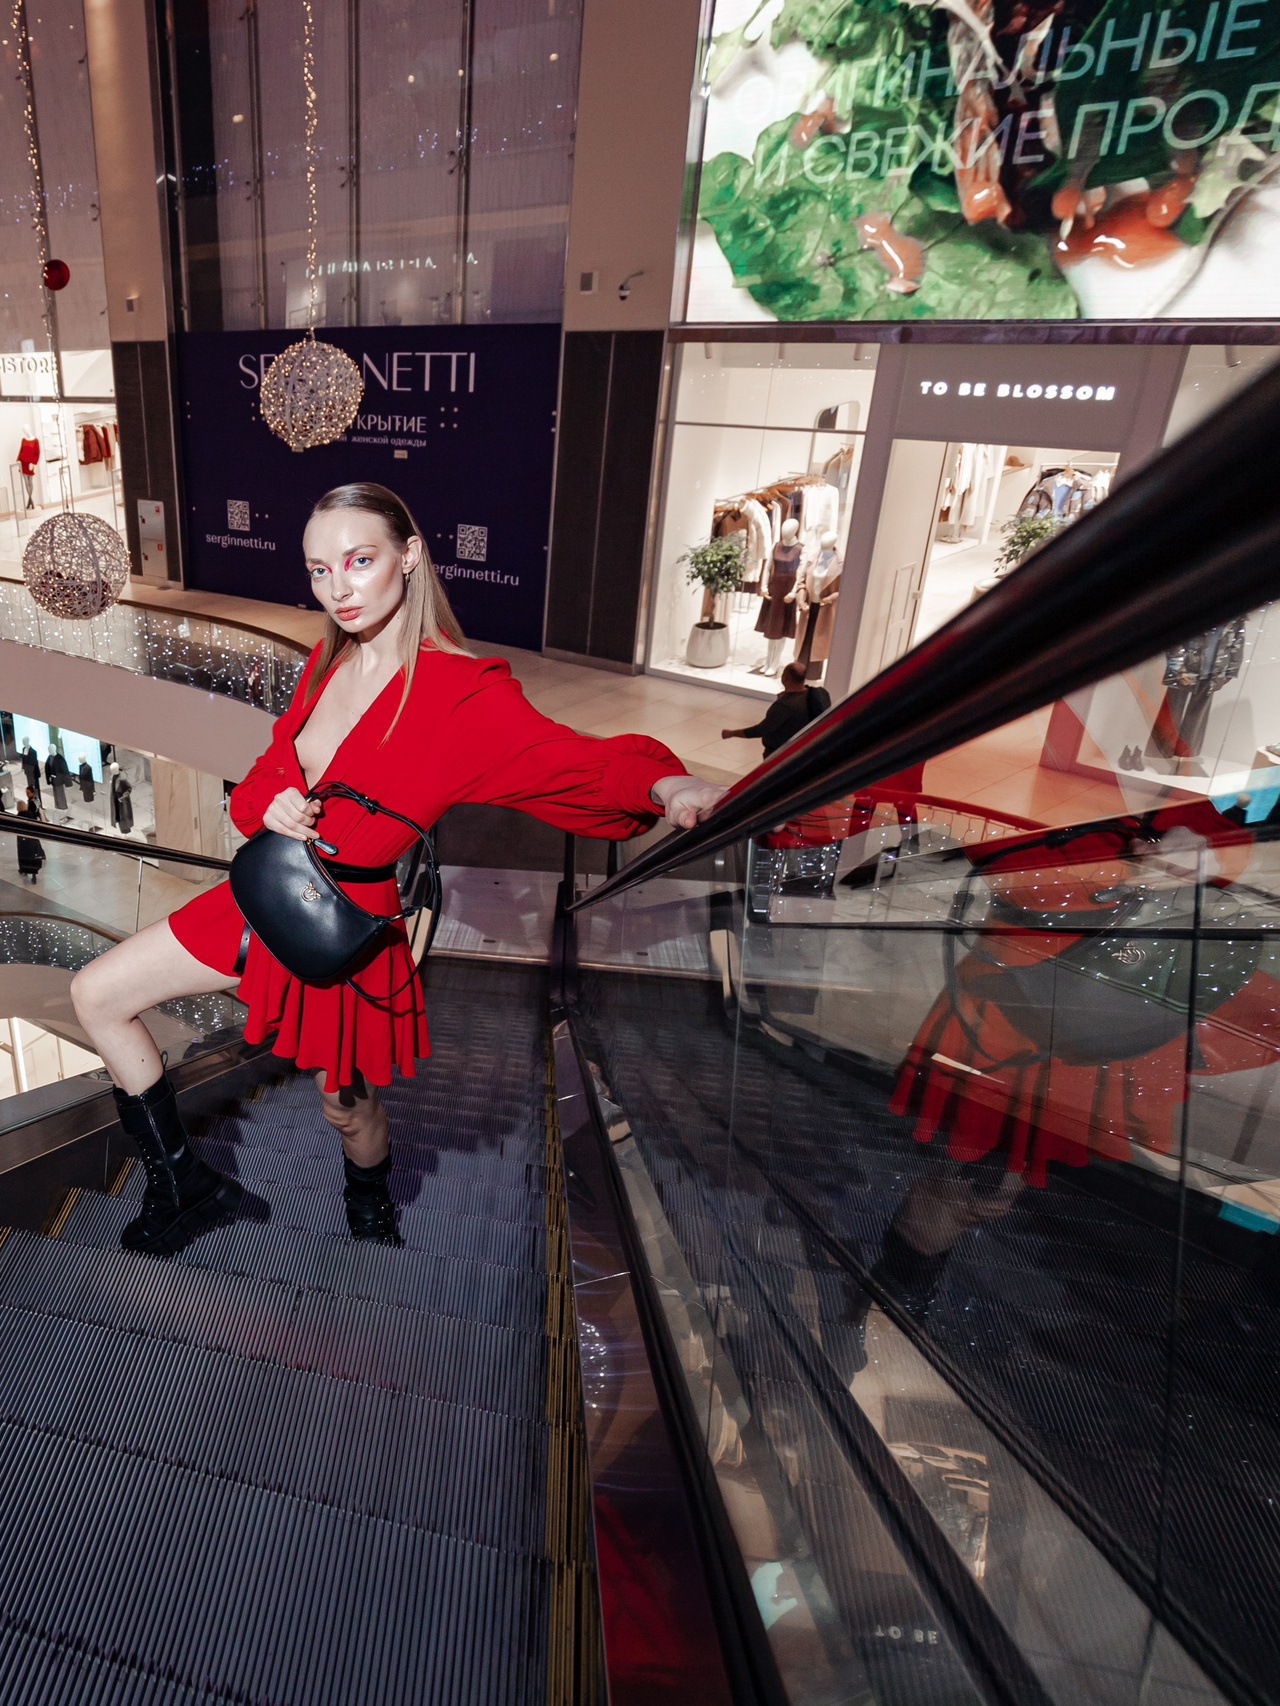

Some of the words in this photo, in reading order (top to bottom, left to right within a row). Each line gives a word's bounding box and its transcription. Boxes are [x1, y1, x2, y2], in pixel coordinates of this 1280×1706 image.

[753, 143, 790, 189] И
[803, 108, 1054, 184] СВЕЖИЕ
[239, 352, 476, 393] SENETTI
[920, 381, 948, 396] TO
[958, 382, 987, 397] BE
[996, 383, 1116, 401] BLOSSOM
[348, 413, 428, 433] КРЫТИЕ
[352, 435, 388, 445] женской
[390, 437, 427, 448] одежды
[205, 533, 276, 550] serginnetti.ru
[432, 563, 520, 586] erginnetti.ru
